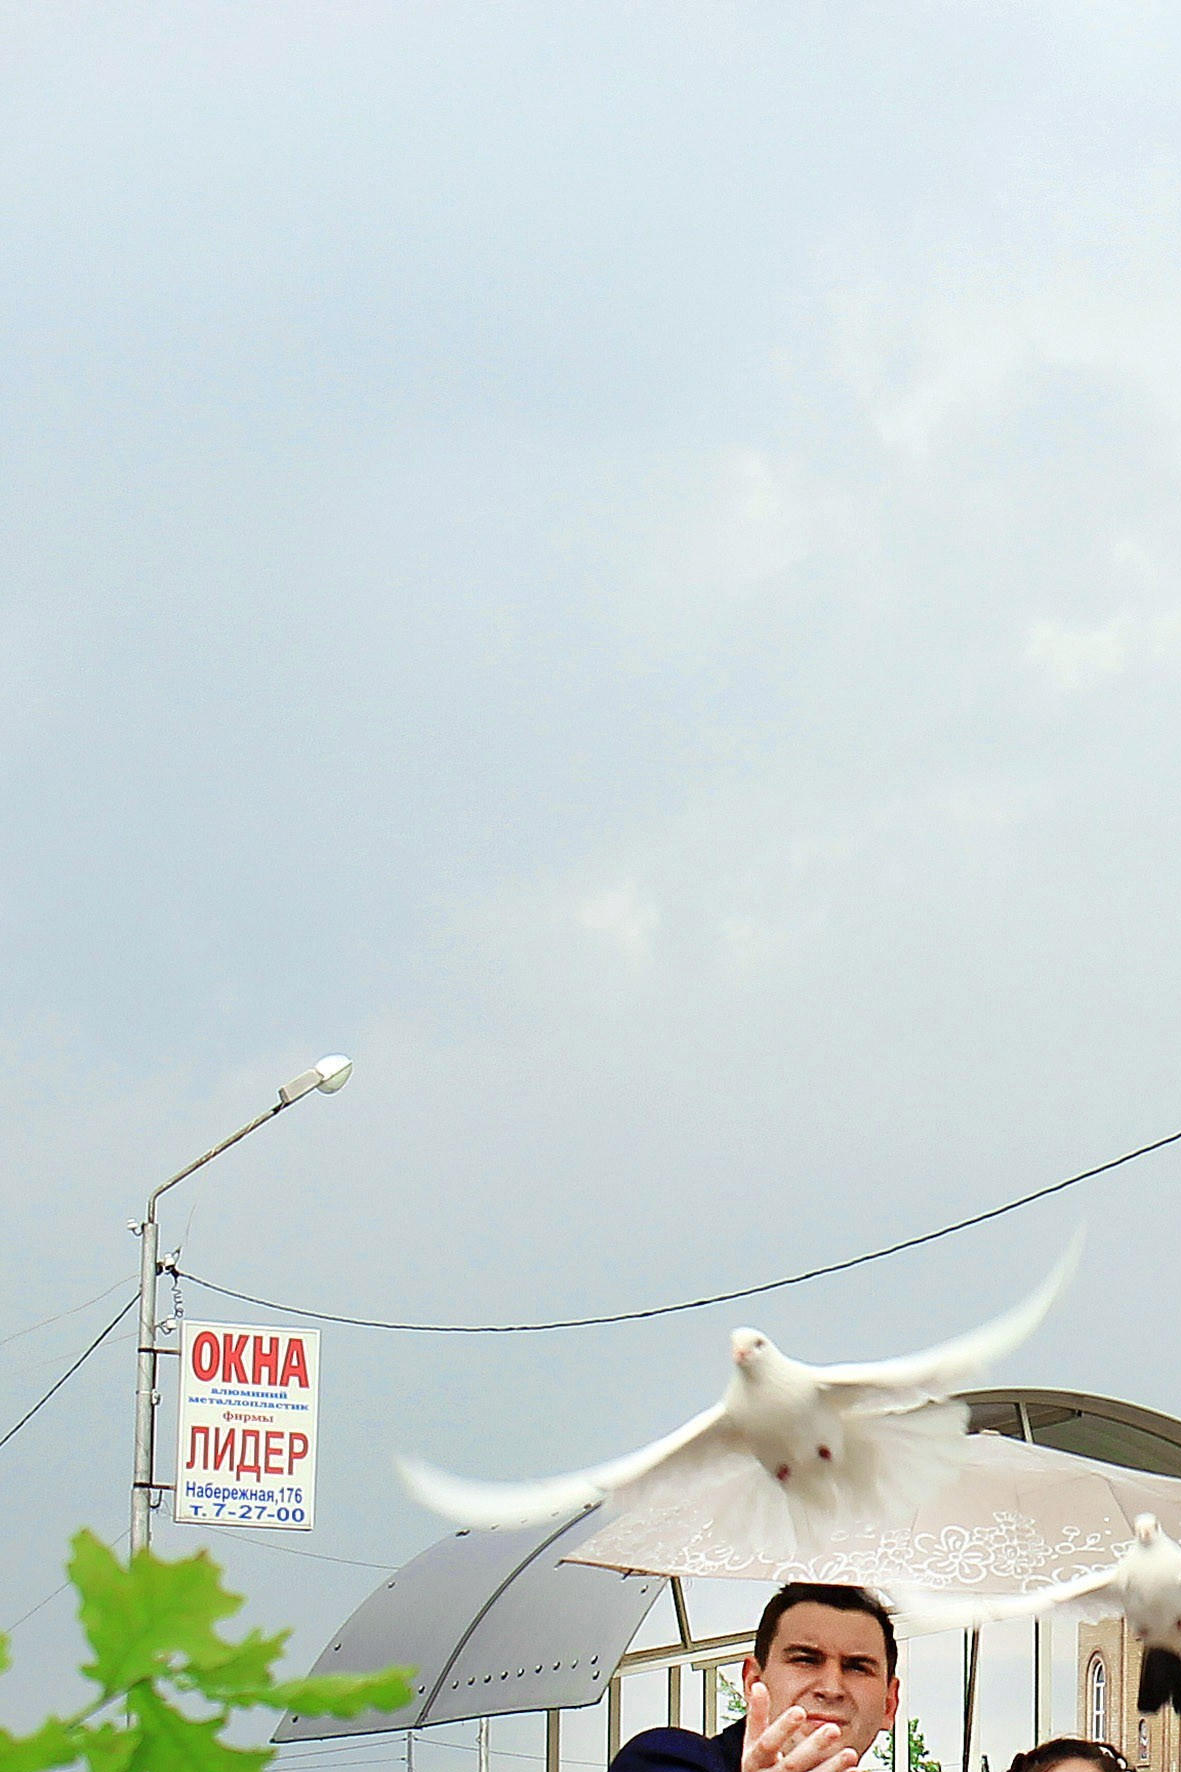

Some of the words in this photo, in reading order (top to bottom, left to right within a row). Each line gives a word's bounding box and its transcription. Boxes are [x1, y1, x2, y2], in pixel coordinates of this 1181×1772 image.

[192, 1331, 310, 1389] ОКНА
[210, 1388, 288, 1400] алюминий
[187, 1396, 309, 1411] металлопластик
[222, 1410, 274, 1424] фирмы
[186, 1425, 309, 1482] ЛИДЕР
[189, 1504, 208, 1518] т.
[212, 1502, 305, 1523] 7-27-00
